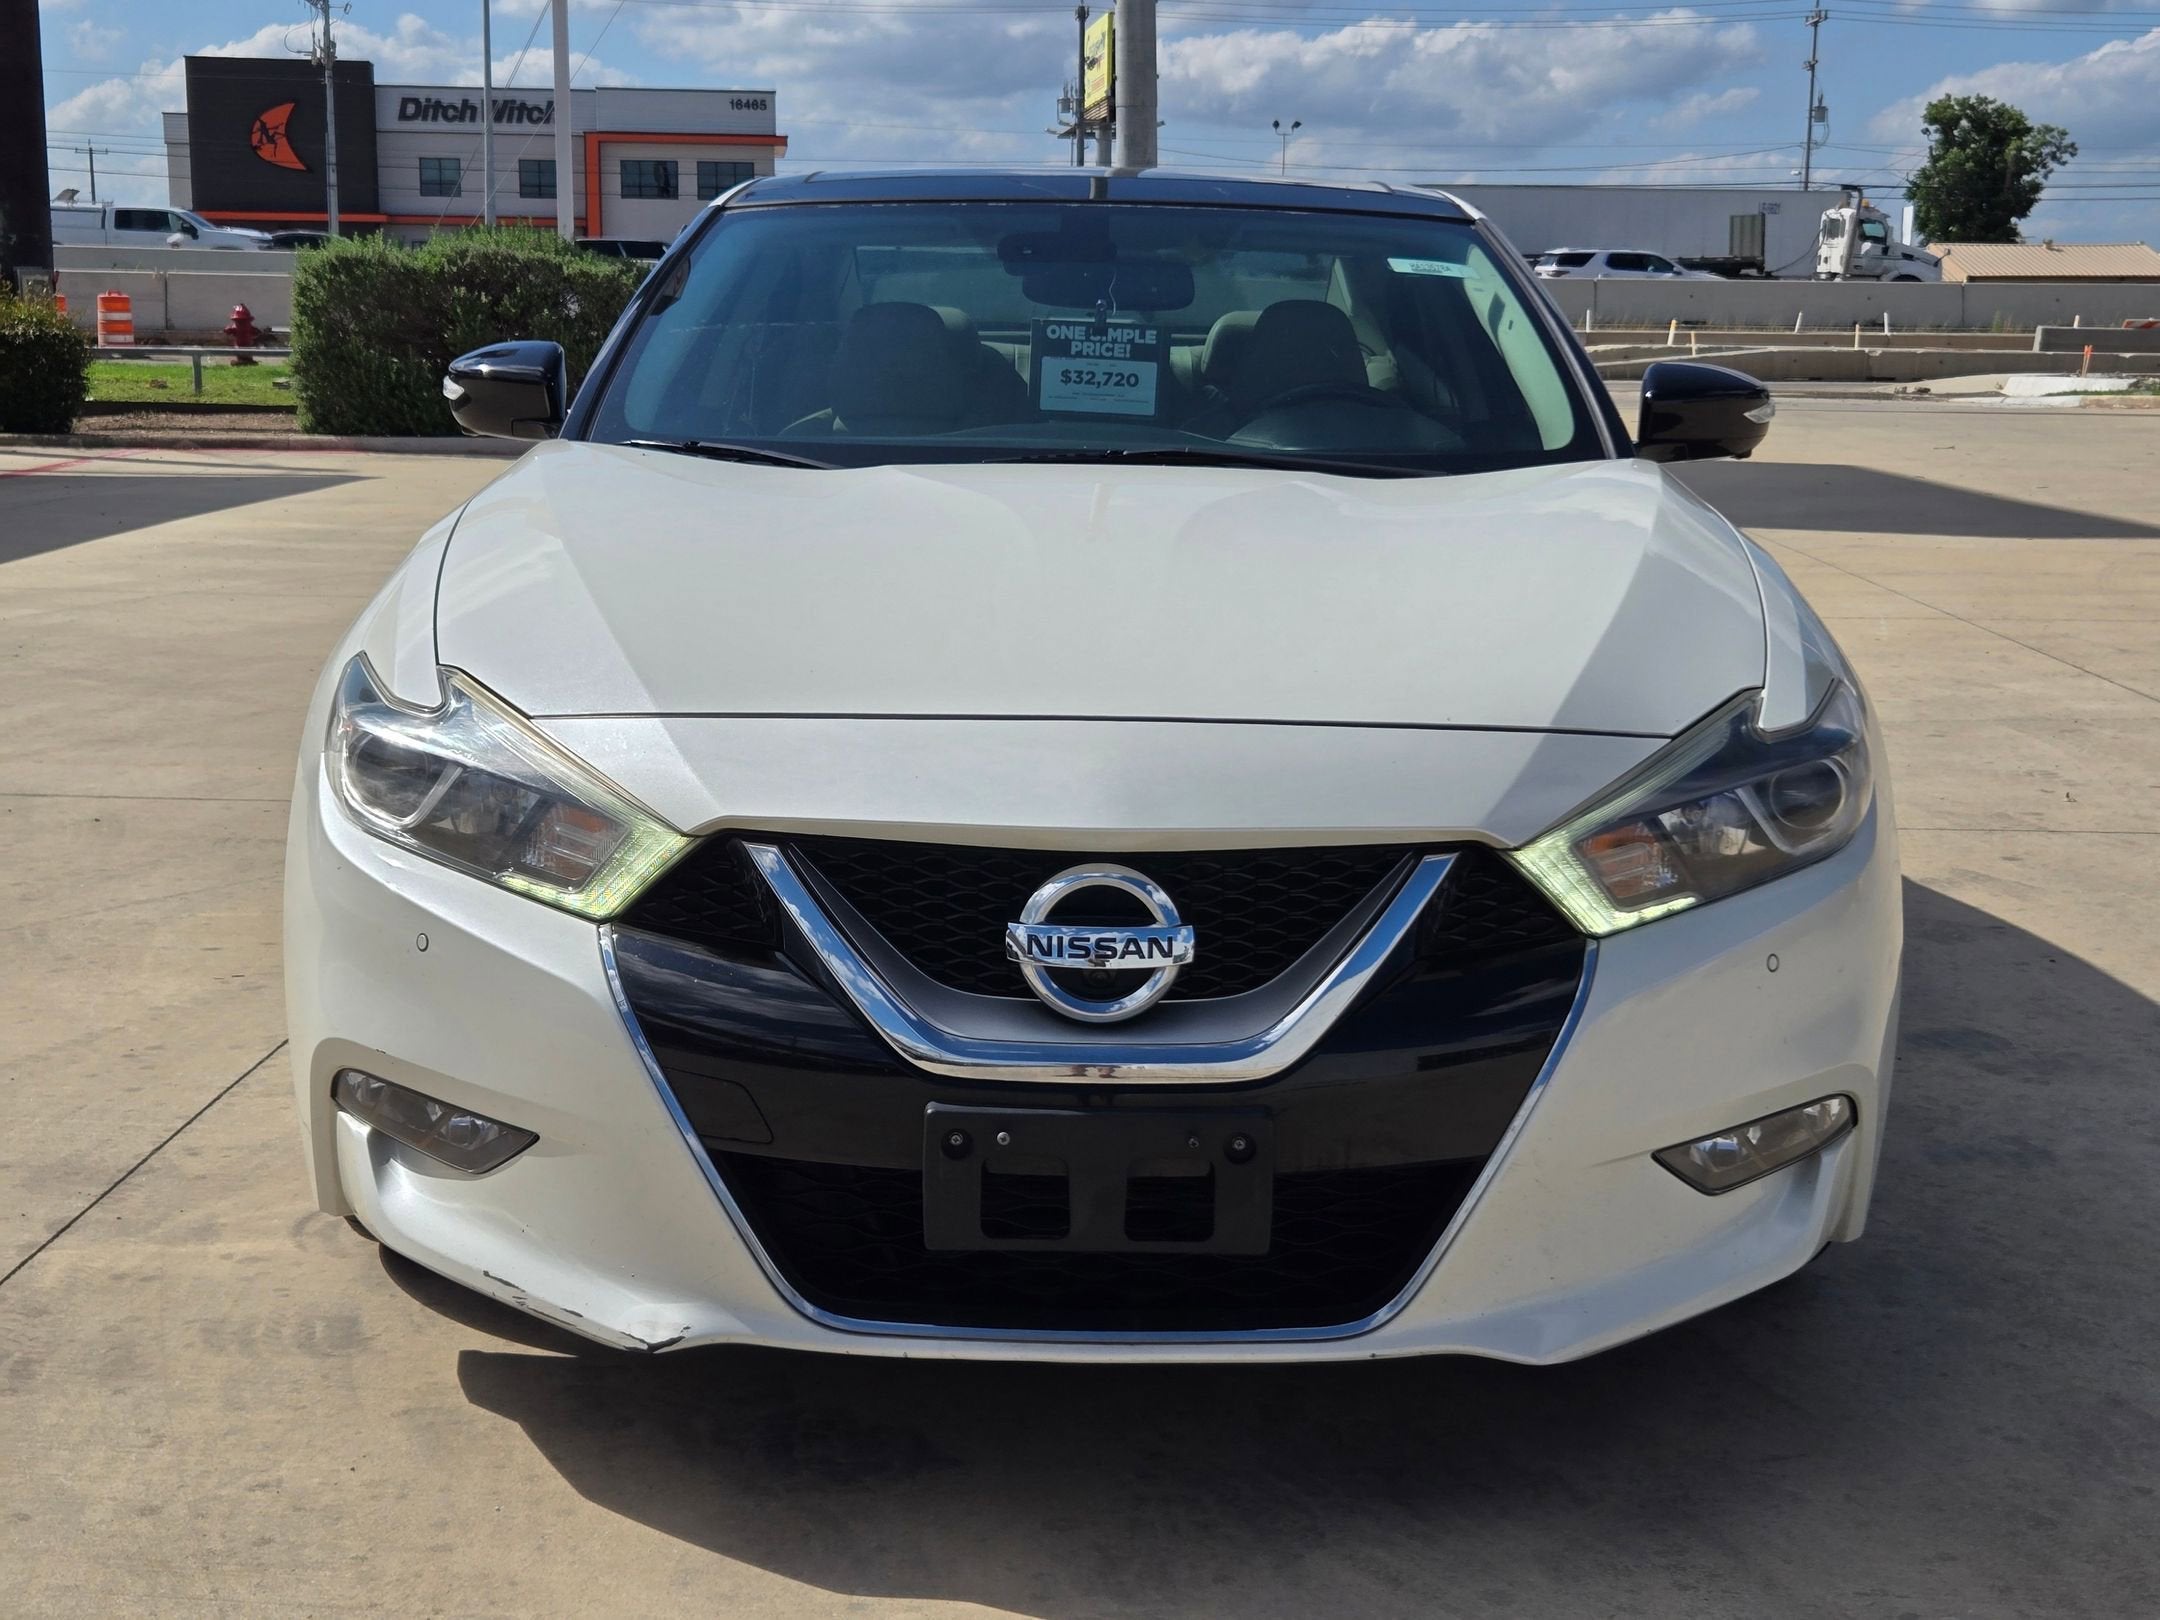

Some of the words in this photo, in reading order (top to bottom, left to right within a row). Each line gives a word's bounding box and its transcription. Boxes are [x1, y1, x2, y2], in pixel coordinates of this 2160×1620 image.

[398, 97, 479, 123] Ditch
[729, 98, 768, 111] 16465
[1046, 324, 1087, 340] ONE
[1089, 327, 1157, 345] MPLE
[1070, 341, 1131, 358] PRICE!
[1060, 368, 1140, 389] $32,720
[1026, 933, 1173, 960] NISSAN
